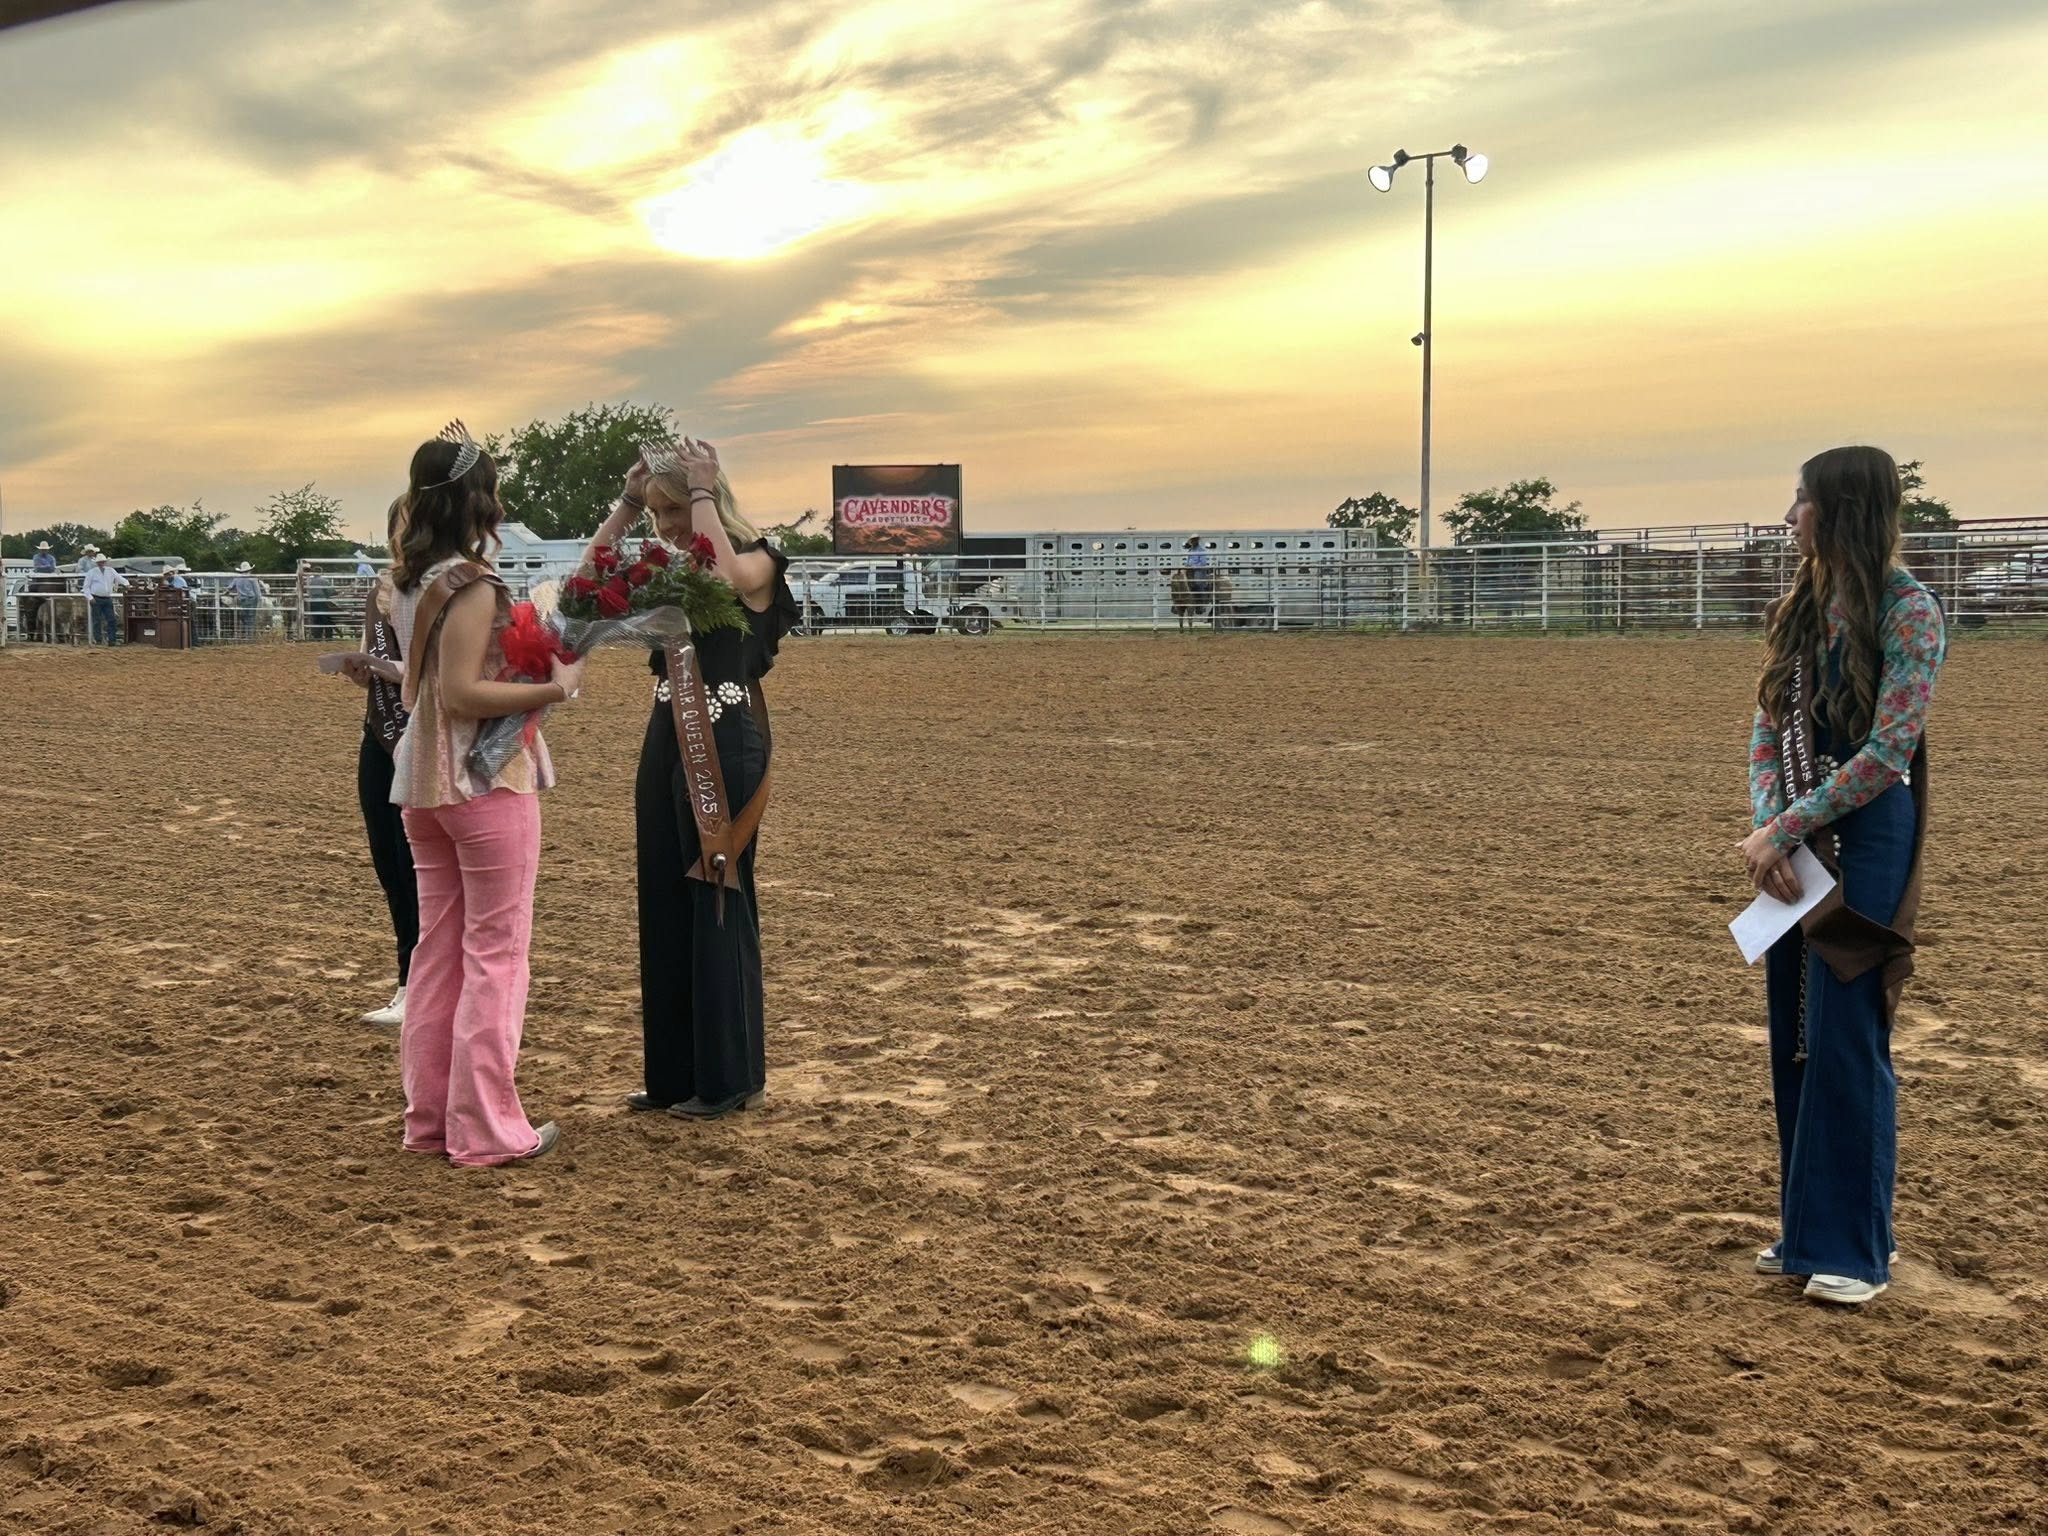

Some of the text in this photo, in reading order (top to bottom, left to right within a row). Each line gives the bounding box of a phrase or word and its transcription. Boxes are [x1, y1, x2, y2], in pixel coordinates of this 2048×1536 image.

[844, 498, 948, 523] CAVENDER'S
[384, 720, 395, 740] Up
[682, 710, 708, 764] QUEEN
[696, 769, 718, 814] 2025
